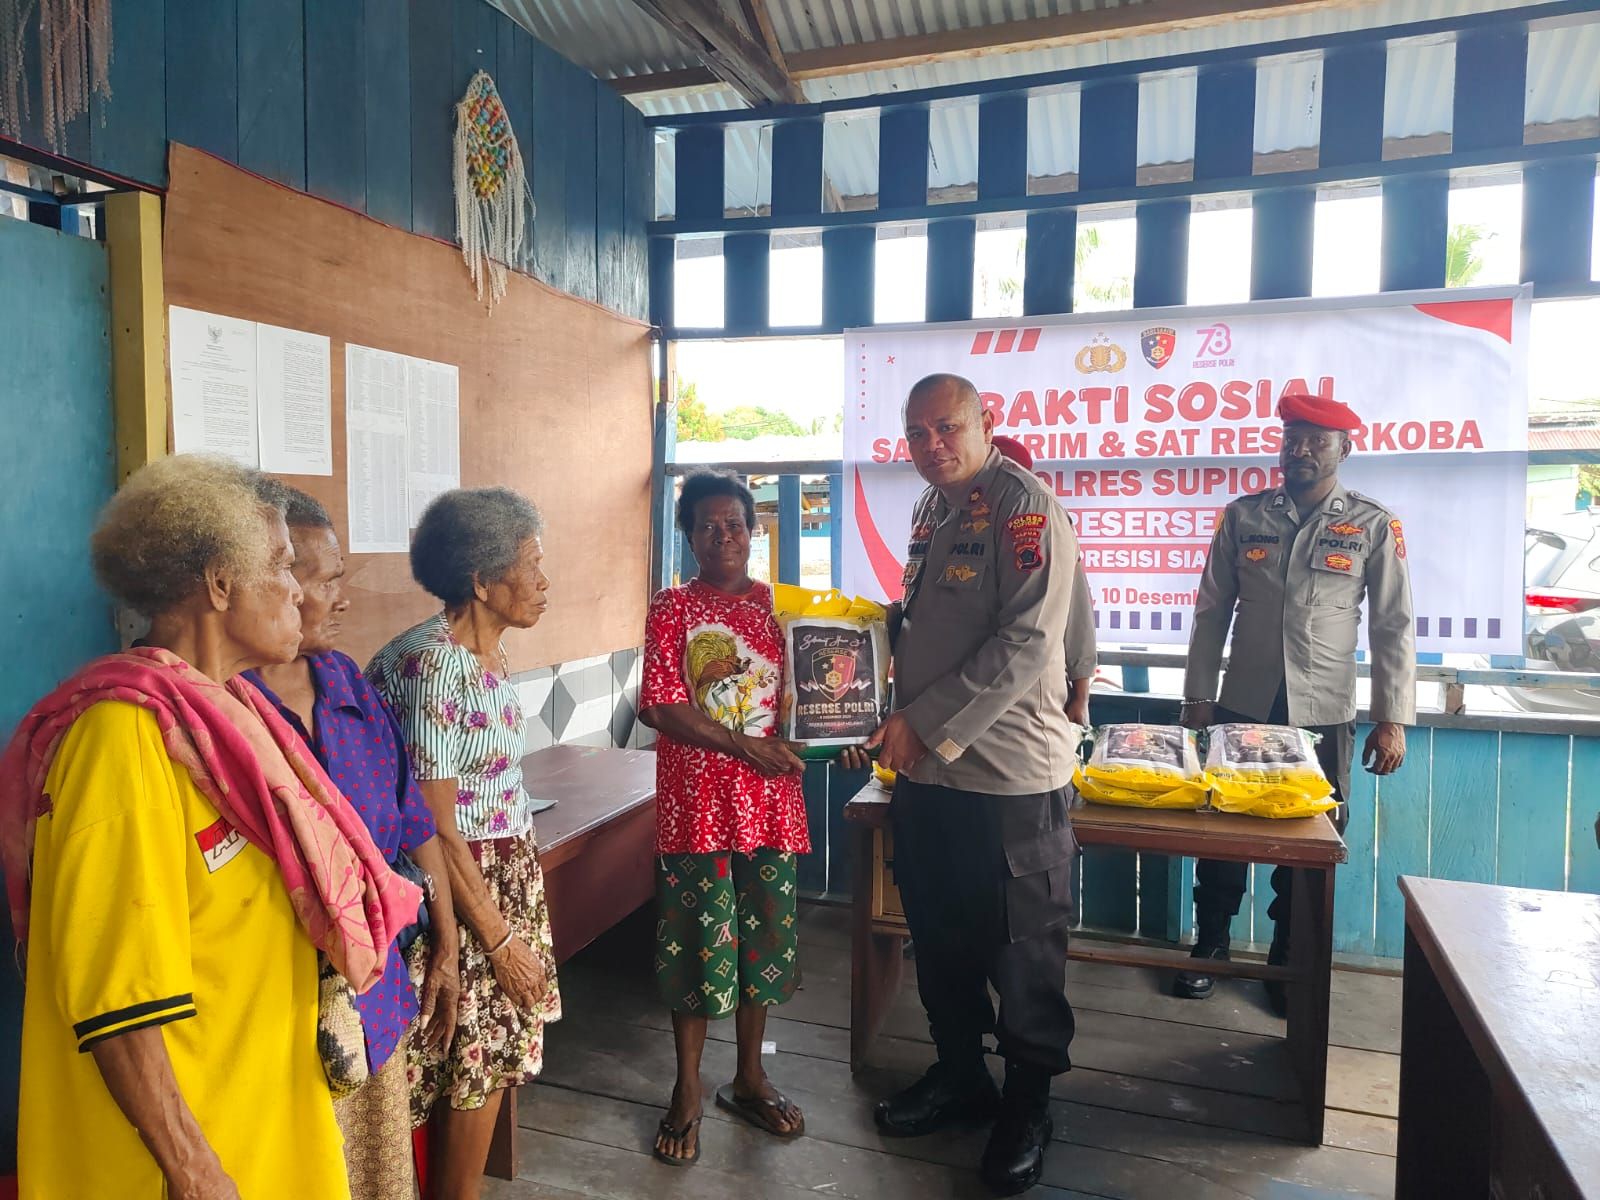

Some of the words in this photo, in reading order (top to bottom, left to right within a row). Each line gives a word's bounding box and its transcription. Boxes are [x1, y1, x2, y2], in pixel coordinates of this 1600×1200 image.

[978, 386, 1130, 428] BAKTI
[872, 437, 913, 463] SA
[1012, 431, 1087, 460] RIM
[1099, 431, 1126, 458] &
[1135, 428, 1201, 457] SAT
[1211, 419, 1484, 456] RESRKOBA
[1319, 538, 1363, 552] POLRI
[1167, 550, 1207, 569] SIA
[1101, 587, 1121, 604] 10
[797, 702, 842, 716] RESERSE
[844, 701, 875, 713] POLRI
